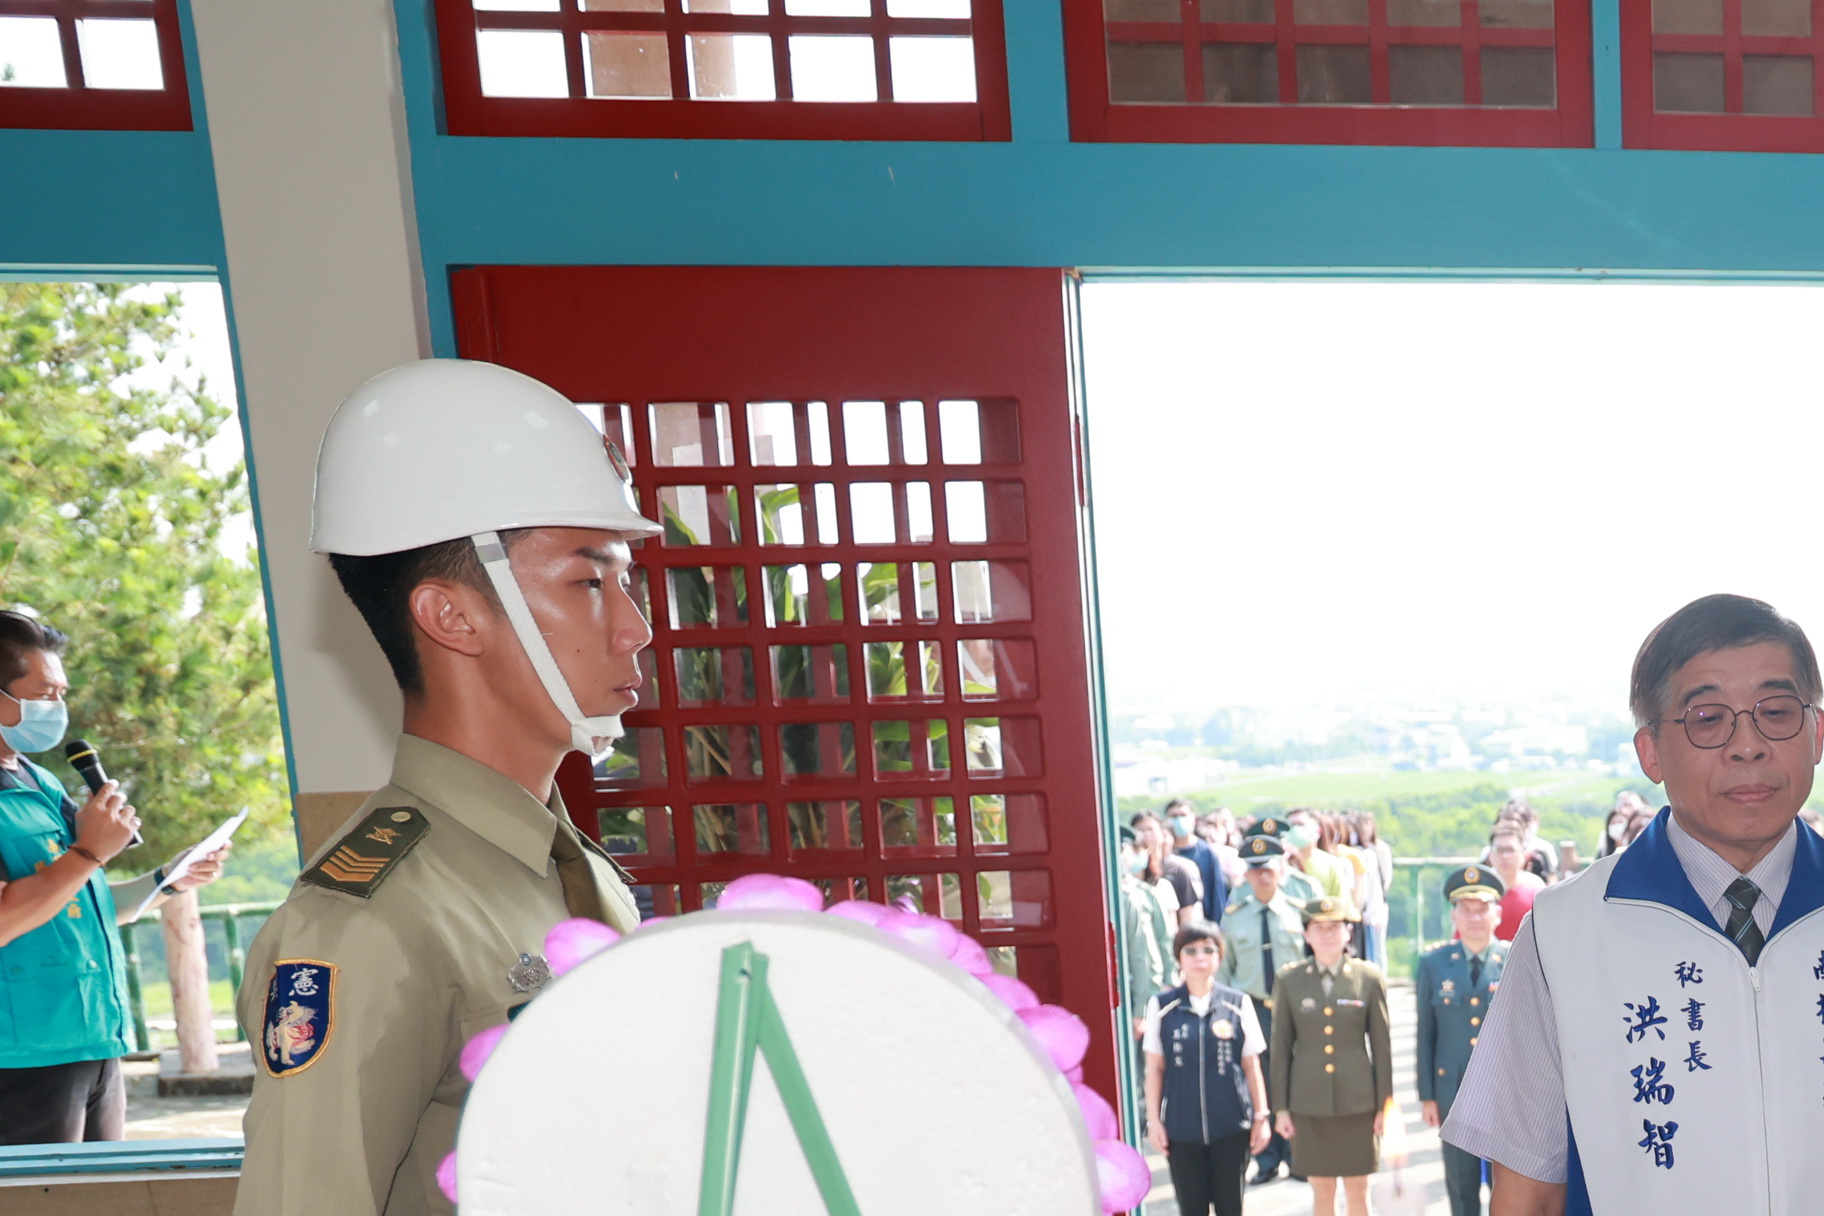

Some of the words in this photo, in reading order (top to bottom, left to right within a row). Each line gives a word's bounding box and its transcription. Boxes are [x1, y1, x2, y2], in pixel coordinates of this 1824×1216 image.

[1622, 995, 1680, 1170] 洪瑞智
[1674, 960, 1713, 1073] 秘書長
